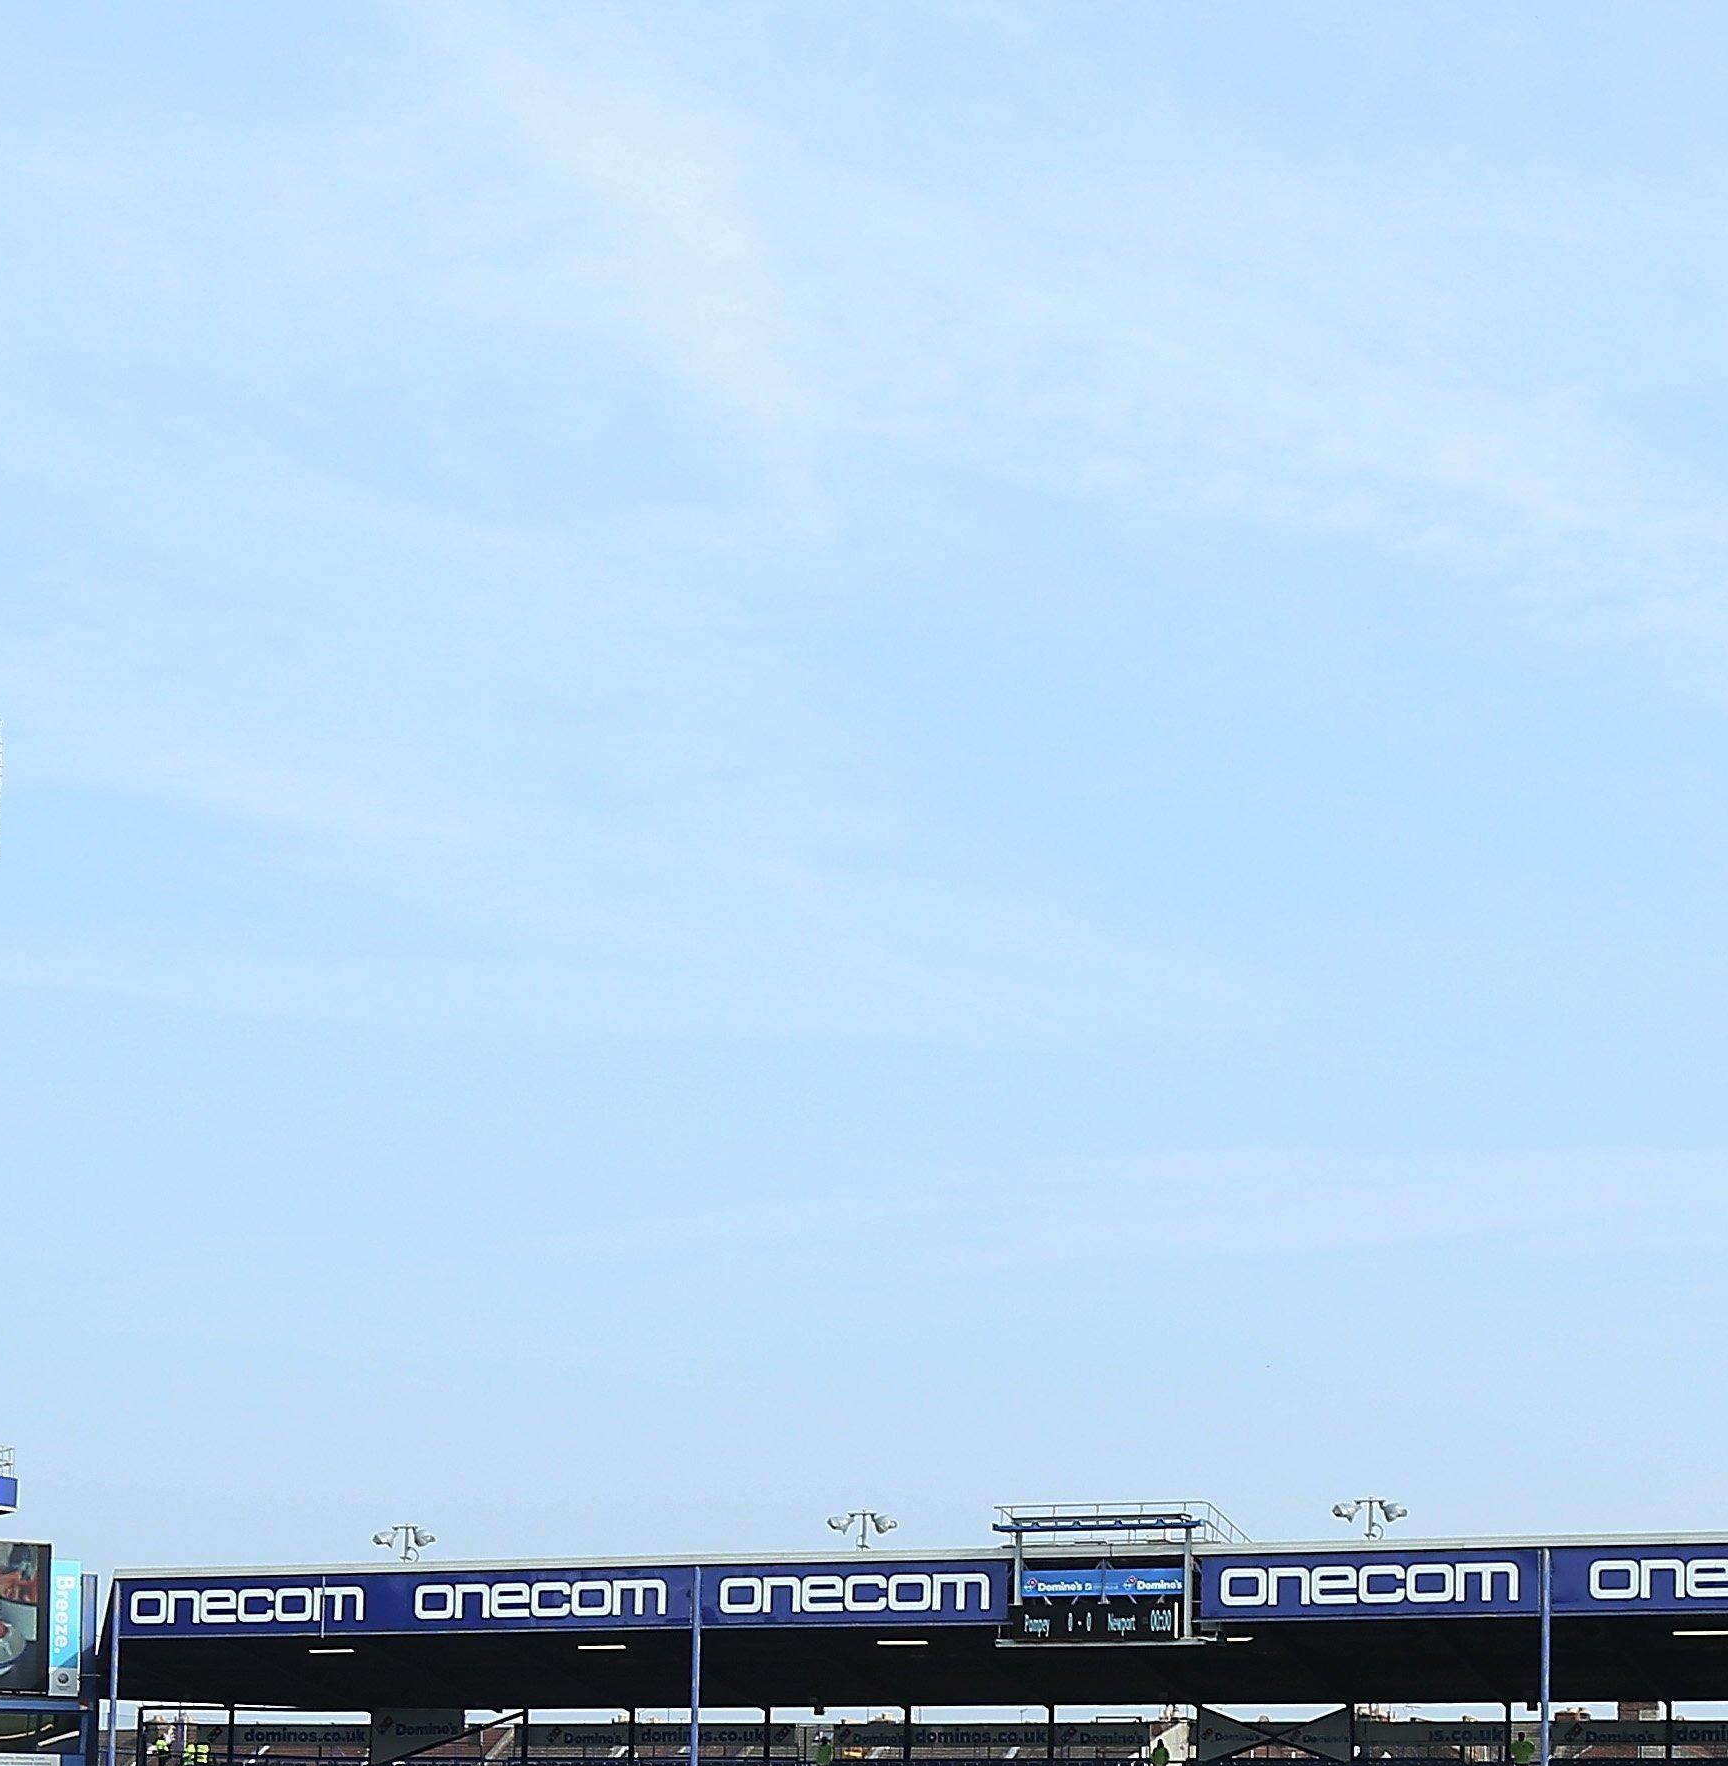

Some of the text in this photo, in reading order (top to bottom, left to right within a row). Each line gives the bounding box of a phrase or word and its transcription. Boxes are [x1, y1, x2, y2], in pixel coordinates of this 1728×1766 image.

[1037, 1581, 1083, 1592] Domino's
[1136, 1579, 1183, 1590] Domino's
[1220, 1562, 1520, 1606] onecom
[414, 1580, 667, 1620] onecom
[719, 1573, 990, 1614] onecom
[130, 1587, 364, 1624] onecom
[54, 1575, 76, 1655] Breeze.
[244, 1728, 365, 1742] dominos.co.uk
[395, 1722, 459, 1737] Domino's
[641, 1728, 765, 1742] domins.co.uk
[916, 1728, 1048, 1743] dominos.co.uk
[1585, 1731, 1657, 1742] Domino's
[564, 1732, 623, 1744] Domino's
[1080, 1732, 1144, 1744] Domino's
